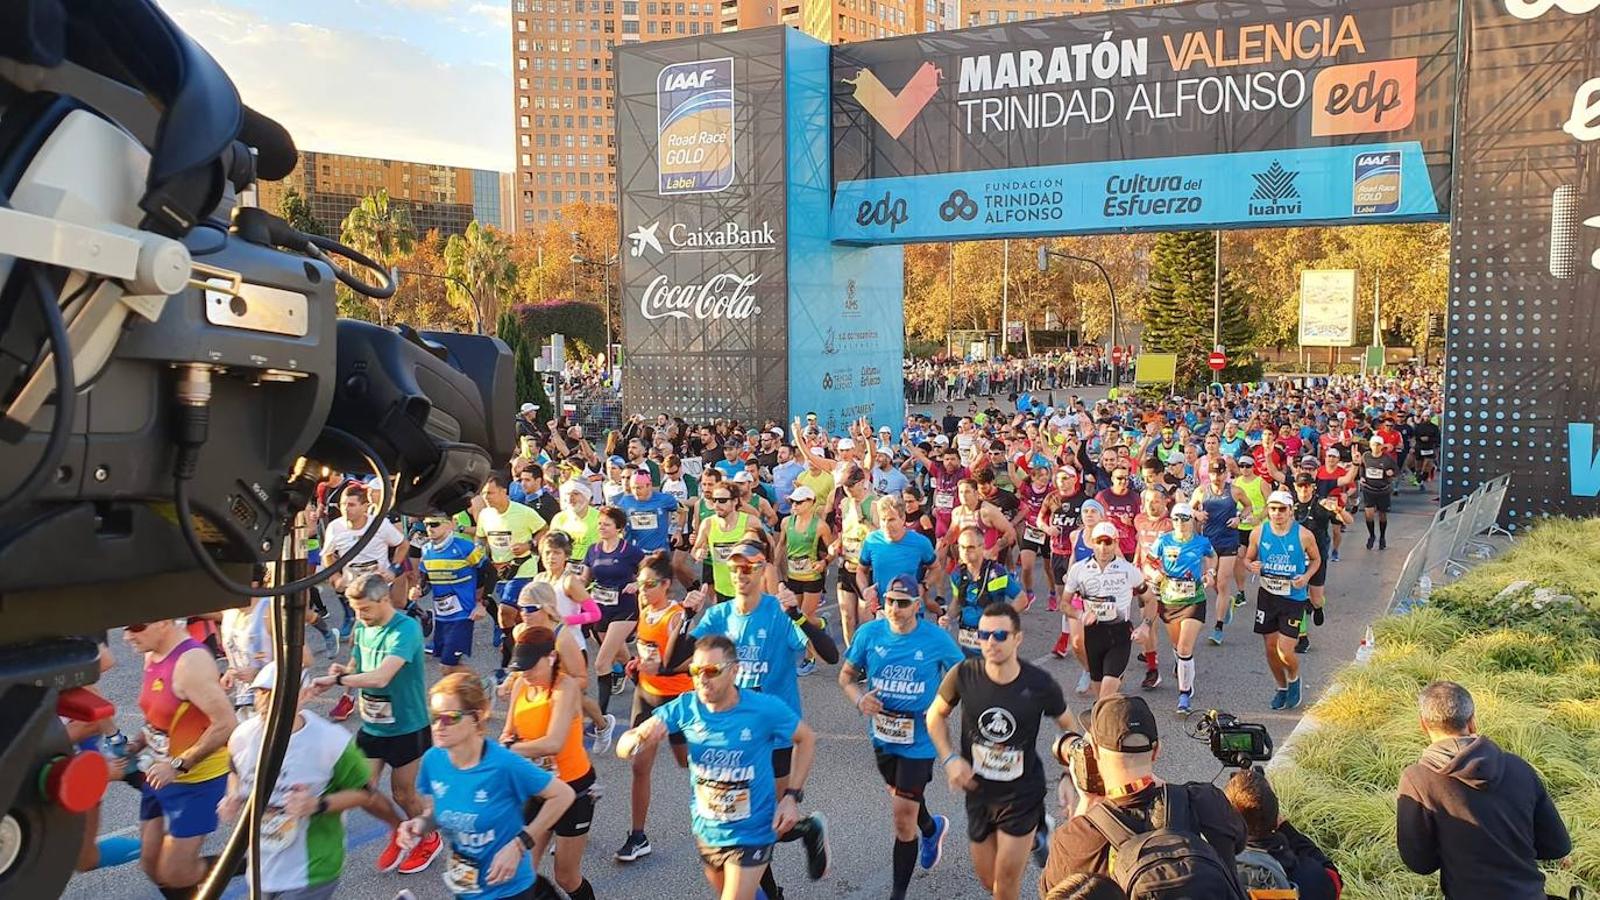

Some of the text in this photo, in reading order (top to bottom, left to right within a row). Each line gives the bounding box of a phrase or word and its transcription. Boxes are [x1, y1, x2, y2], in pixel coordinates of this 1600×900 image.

[958, 15, 1366, 94] MARATÓN VALENCIA
[664, 68, 716, 92] IAAF
[957, 86, 1116, 135] TRINIDAD
[1125, 69, 1306, 121] ALFONSO
[1324, 70, 1401, 123] edp
[668, 131, 727, 146] Road Race
[666, 148, 704, 166] GOLD
[1358, 155, 1391, 166] IAAF
[666, 175, 696, 190] Label
[985, 178, 1063, 193] FUNDACIÓN
[1105, 173, 1203, 194] Cultura del
[984, 191, 1063, 209] TRINIDAD
[1103, 194, 1203, 217] Esfuerzo
[1357, 192, 1382, 202] GOLD
[856, 191, 909, 234] edp
[984, 207, 1063, 224] ALFONSO
[1248, 200, 1302, 216] luanvi
[669, 221, 776, 247] CaixaBank
[881, 664, 917, 681] 42K
[871, 677, 926, 695] VALENCIA
[700, 747, 745, 768] 42K
